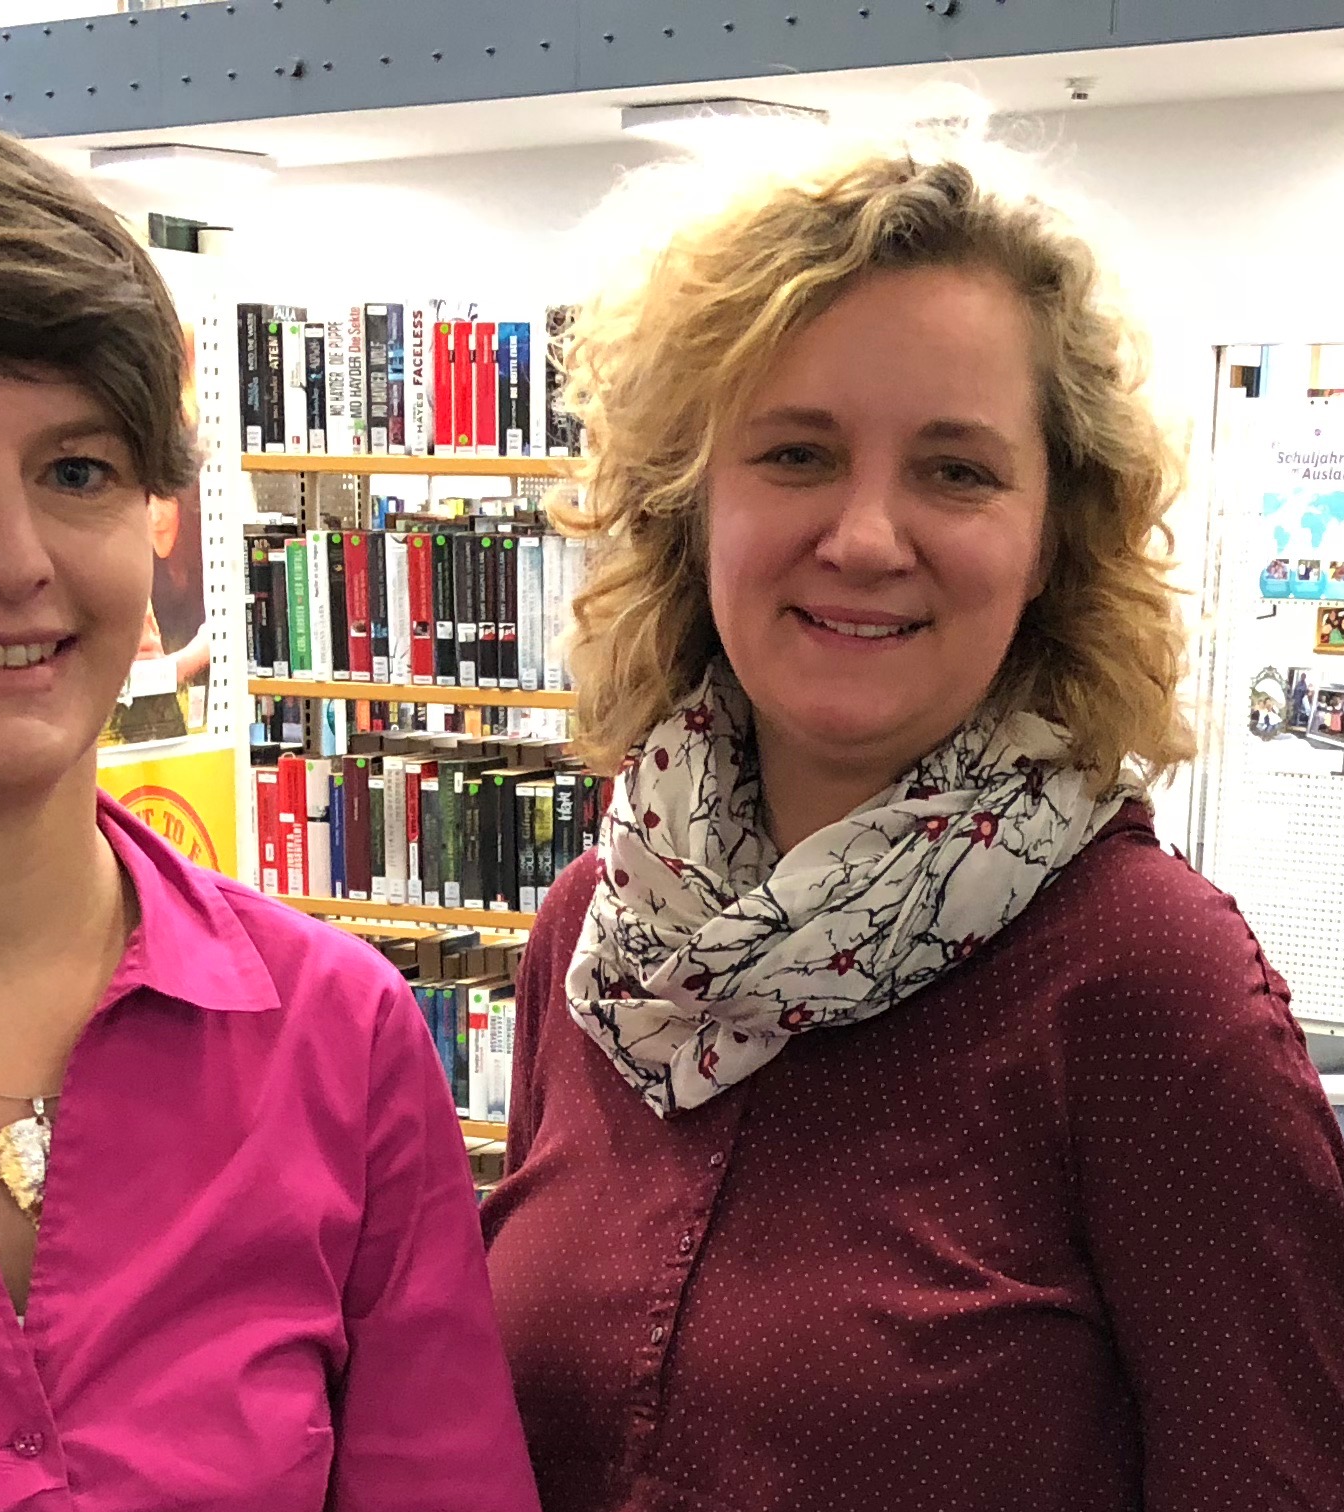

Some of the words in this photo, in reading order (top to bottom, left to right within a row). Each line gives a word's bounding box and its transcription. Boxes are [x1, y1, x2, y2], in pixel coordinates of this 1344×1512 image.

[348, 307, 361, 334] Sekte
[349, 337, 361, 352] Die
[412, 310, 423, 385] FACELESS
[349, 356, 362, 397] HAYDER
[349, 401, 362, 418] MO
